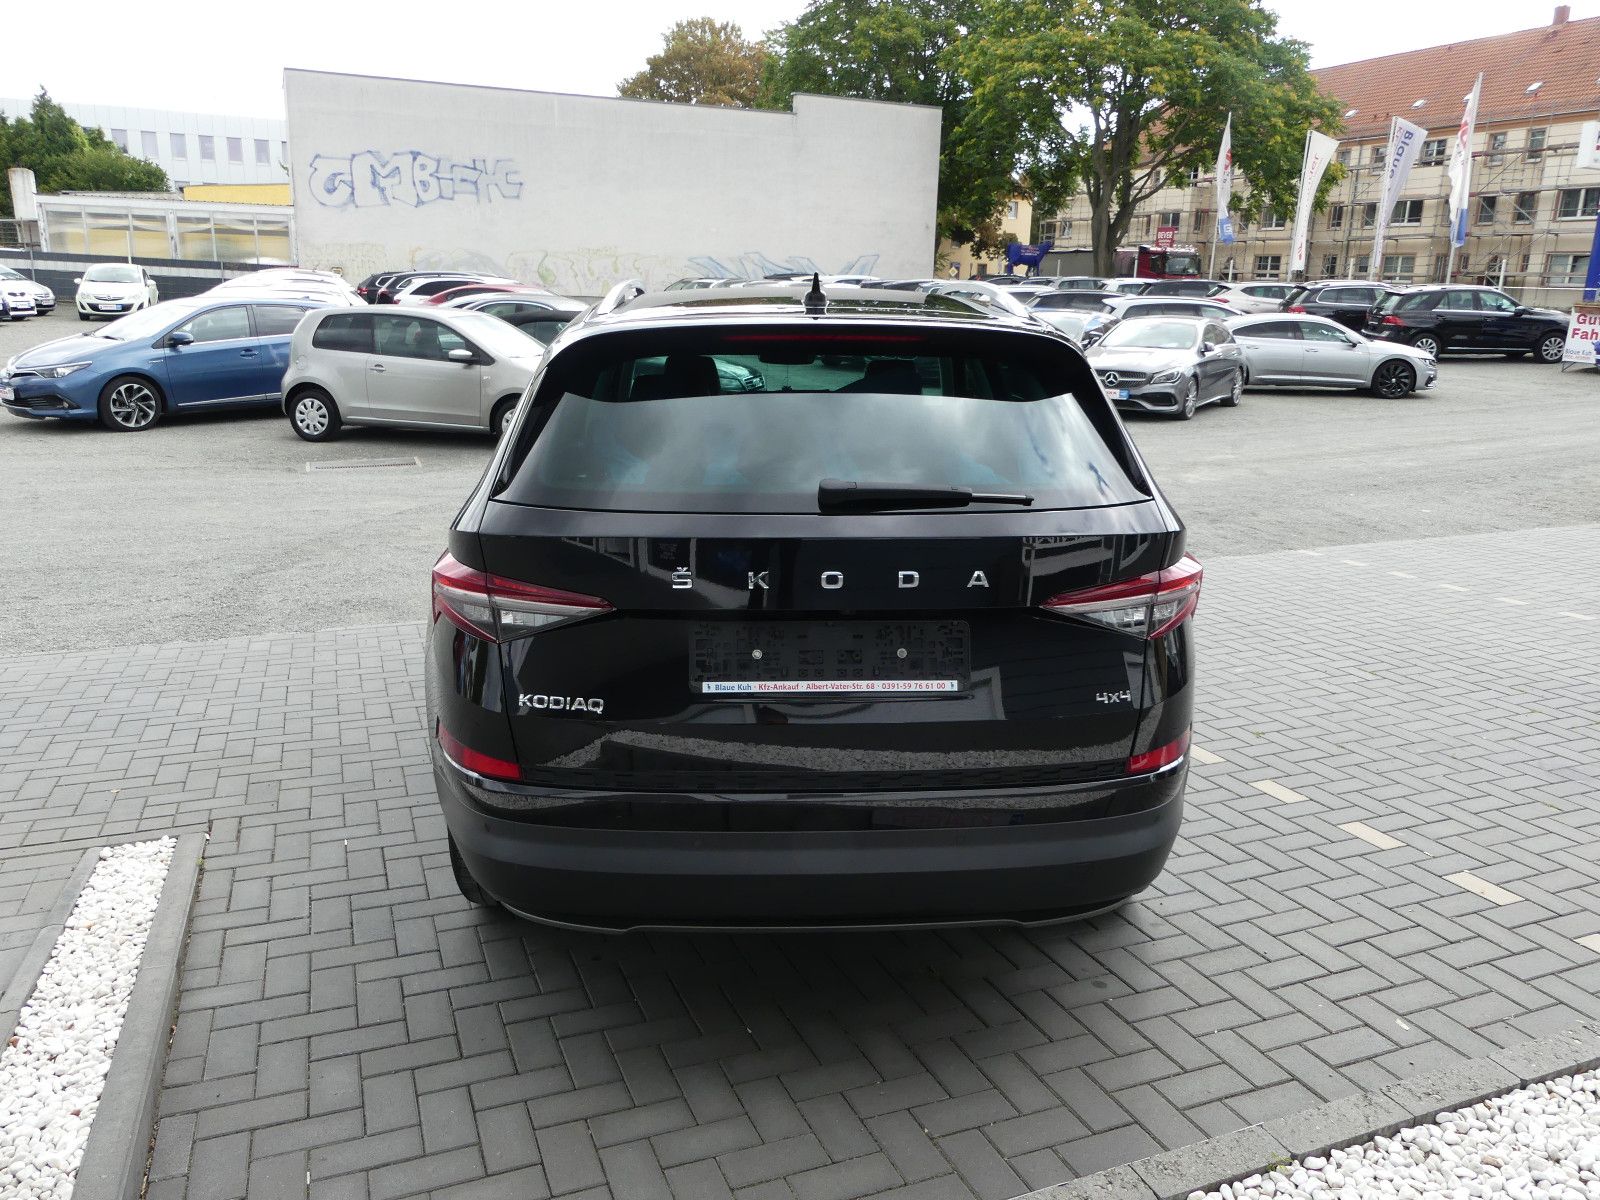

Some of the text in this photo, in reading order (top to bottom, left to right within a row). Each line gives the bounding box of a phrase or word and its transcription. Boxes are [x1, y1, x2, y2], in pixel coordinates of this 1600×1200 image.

[714, 682, 946, 691] Blaue Kuh Kfz-Ankauf Albert-Vater-Str. 68 0391-59 76 61 00
[518, 693, 604, 714] KODIAQ
[1095, 690, 1131, 704] 4x4
